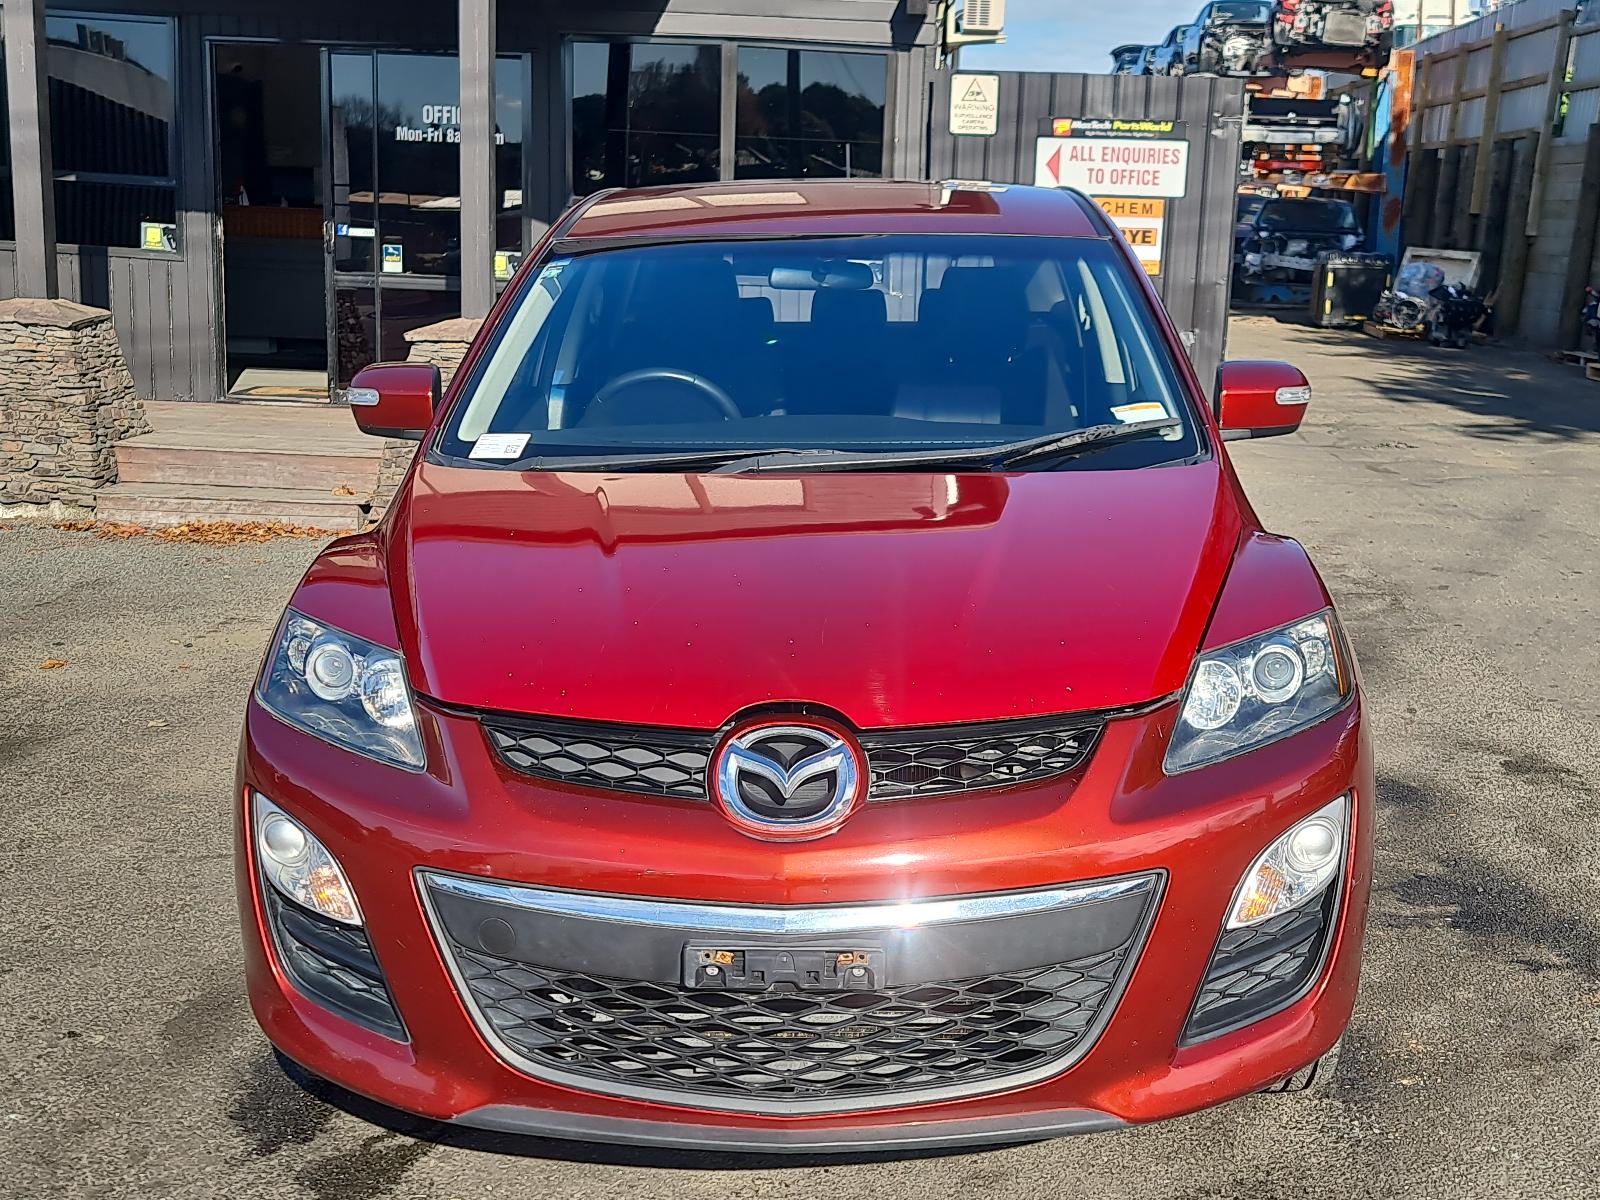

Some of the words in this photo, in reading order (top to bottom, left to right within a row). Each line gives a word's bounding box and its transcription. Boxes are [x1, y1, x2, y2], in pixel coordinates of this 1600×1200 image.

[422, 105, 461, 124] OFFI
[395, 126, 443, 143] Mon-Fri
[1069, 145, 1096, 163] ALL
[1101, 146, 1181, 165] ENQUIRIES
[1087, 168, 1104, 185] TO
[1110, 169, 1161, 186] OFFICE
